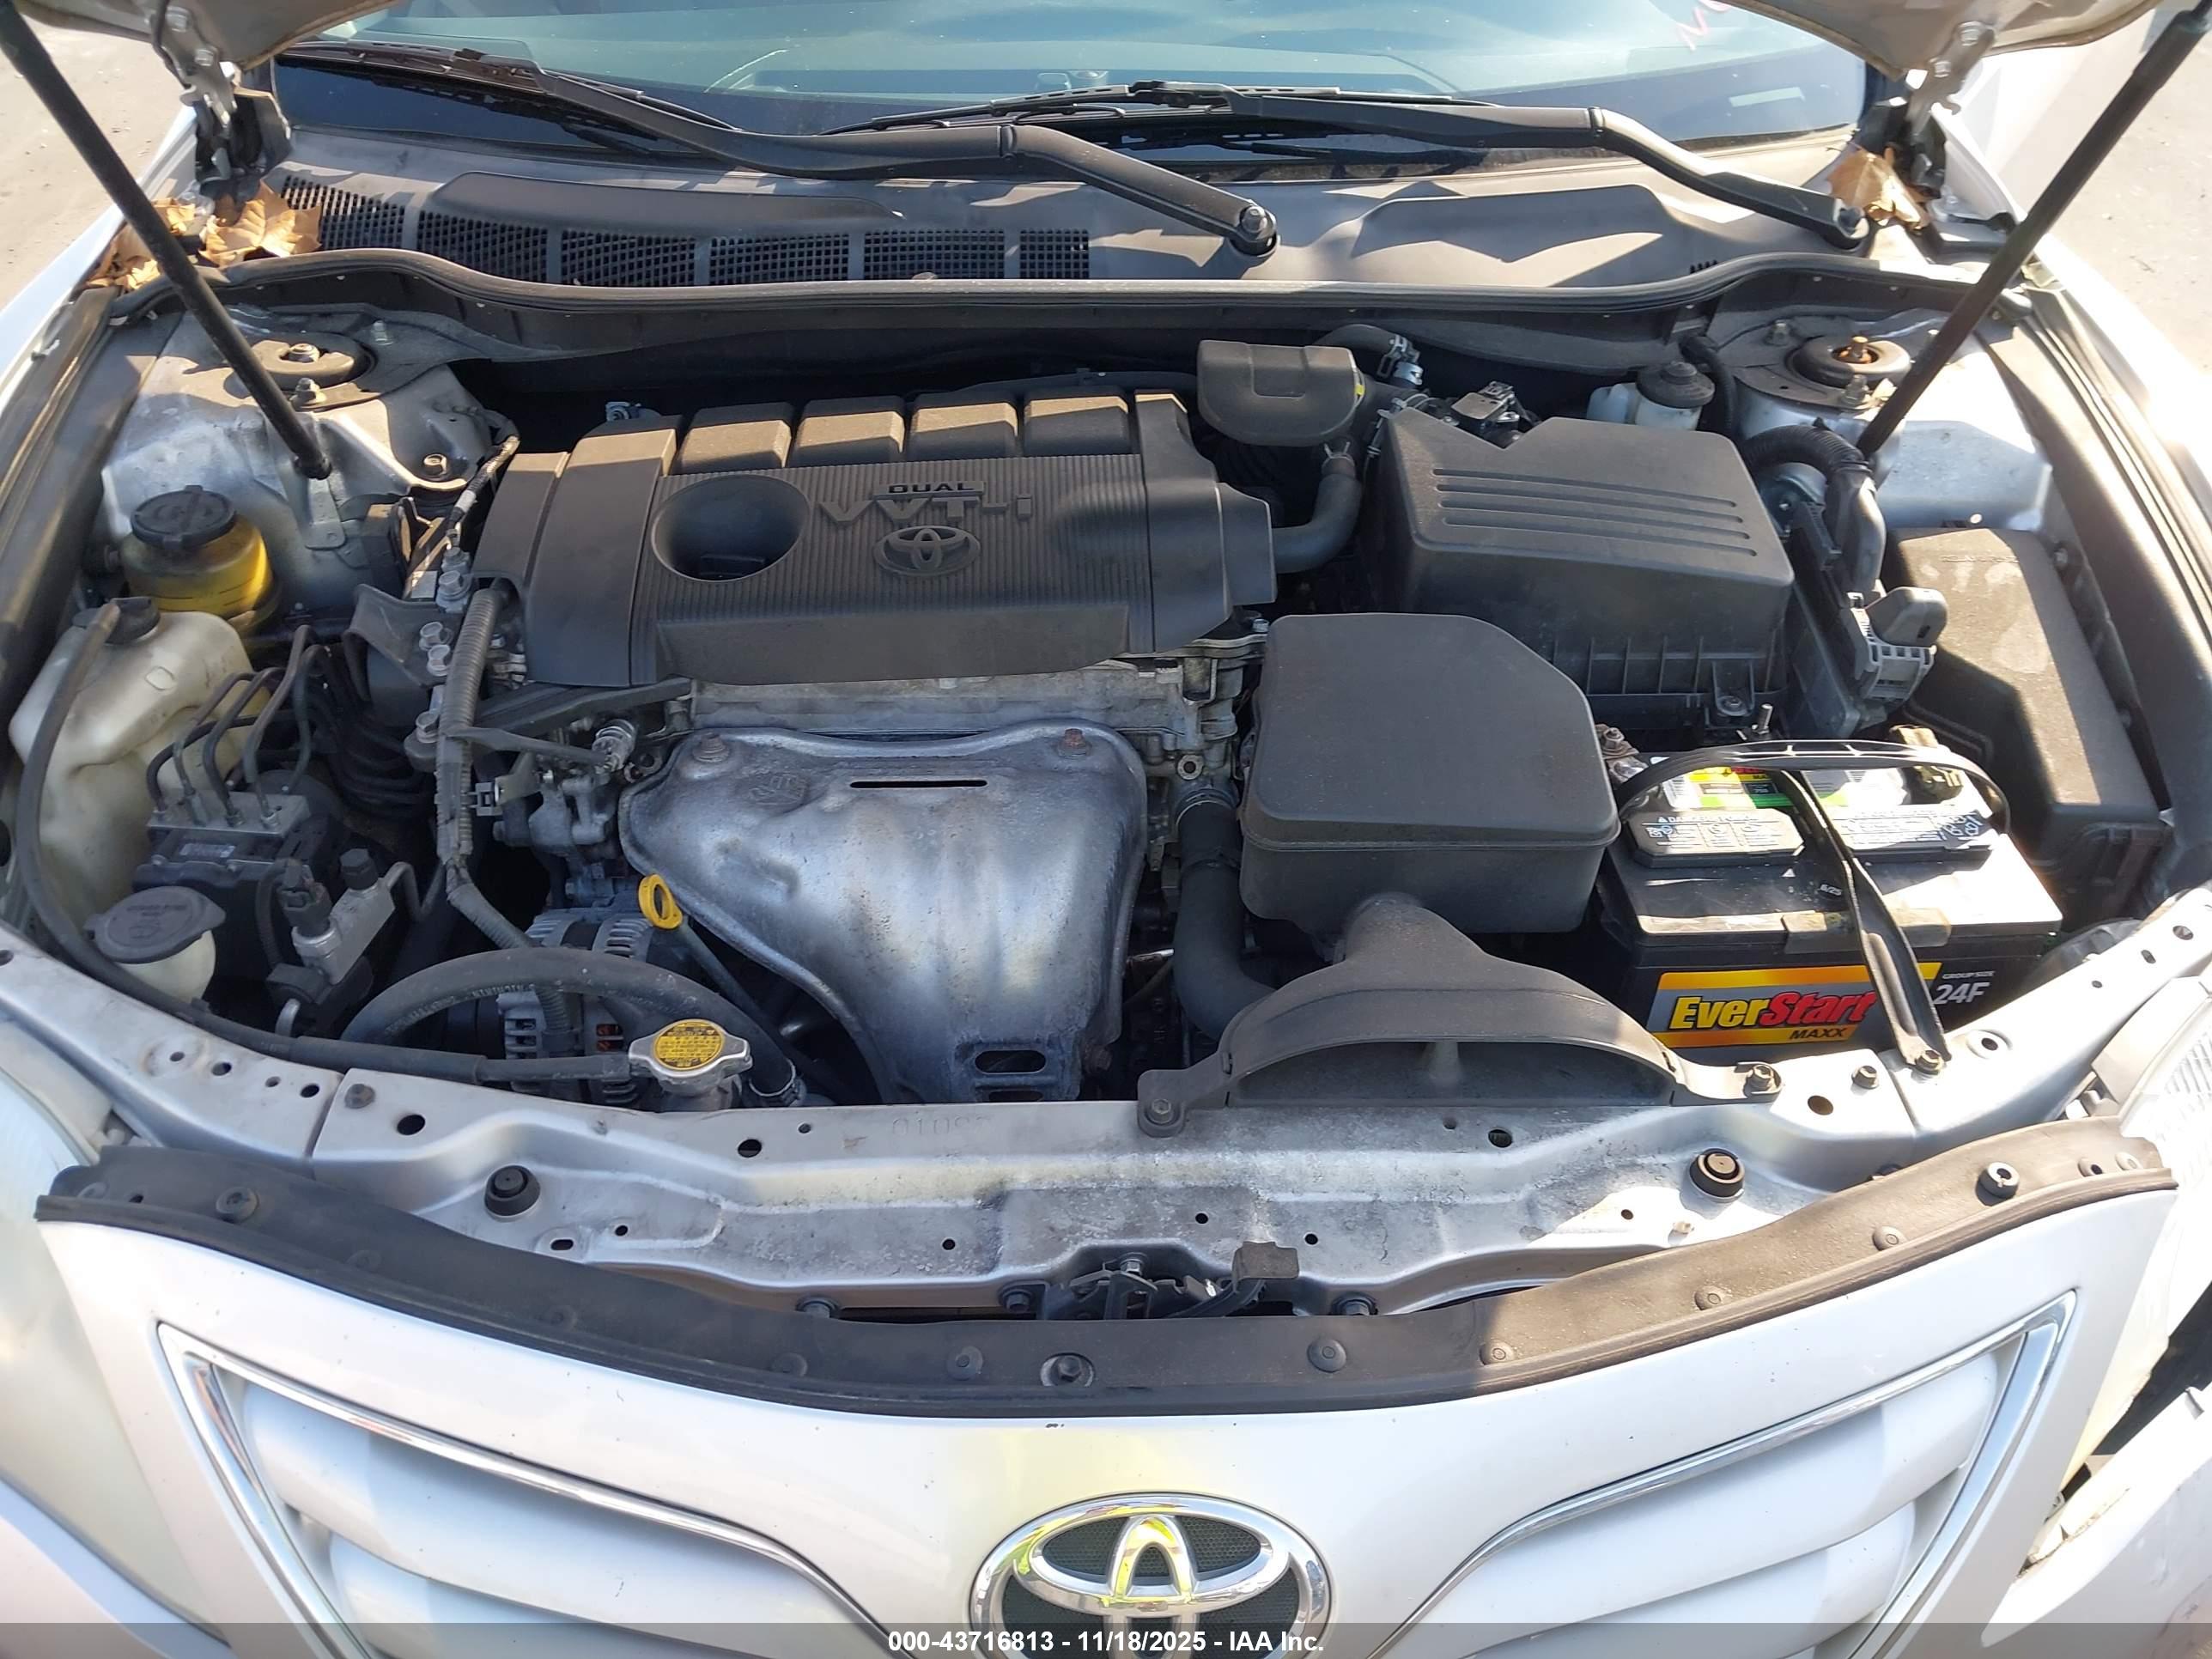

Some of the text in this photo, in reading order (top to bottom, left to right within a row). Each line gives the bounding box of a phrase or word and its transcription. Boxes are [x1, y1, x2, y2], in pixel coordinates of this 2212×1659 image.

[888, 482, 975, 494] DUAL
[1933, 981, 1990, 1005] 24F
[1668, 990, 1877, 1030] EverStart
[1789, 1028, 1846, 1041] MAXX
